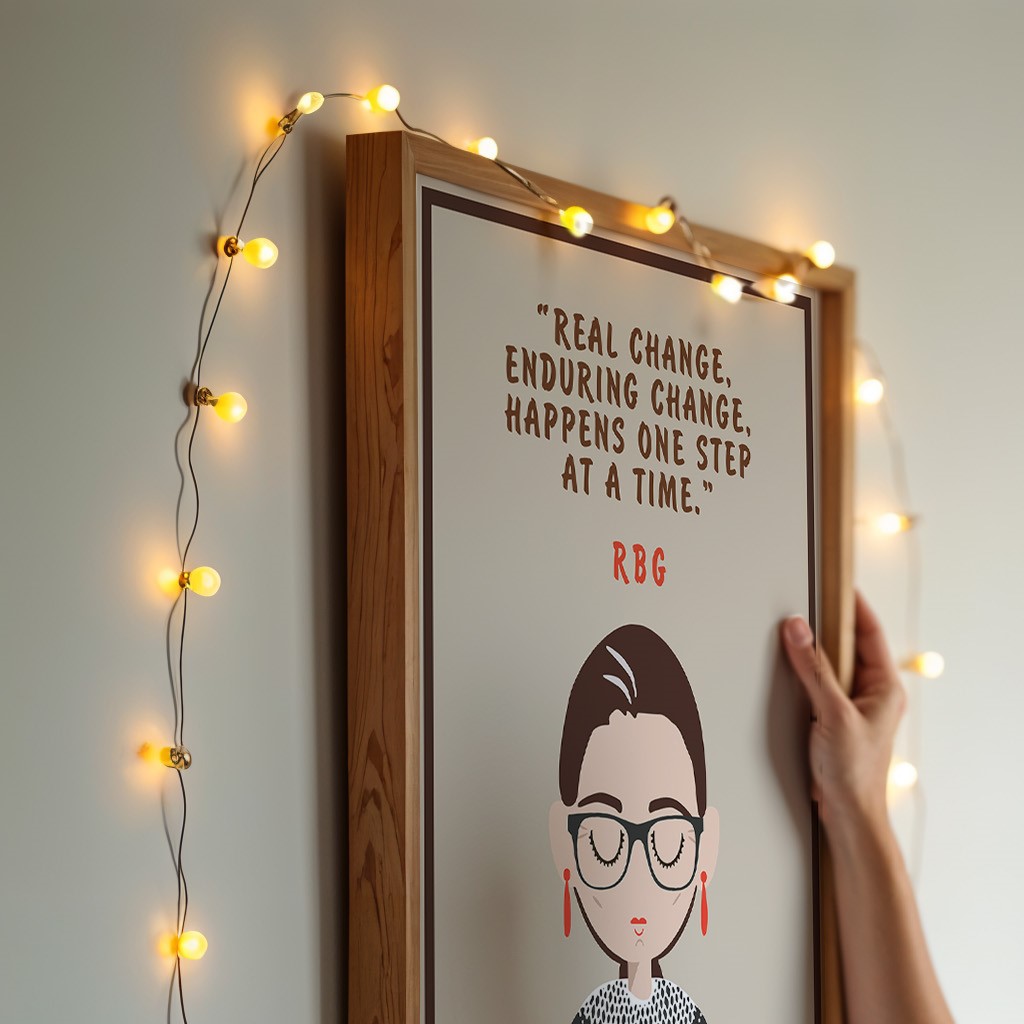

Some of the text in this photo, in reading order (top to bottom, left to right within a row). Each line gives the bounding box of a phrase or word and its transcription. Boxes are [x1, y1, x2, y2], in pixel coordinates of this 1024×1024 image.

[629, 326, 732, 389] CHANGE,
[505, 344, 752, 438] ENDURING CHANGE,
[504, 392, 752, 479] HAPPENS ONE STEP
[561, 453, 594, 496] AT
[604, 461, 622, 502] A
[612, 540, 667, 587] RBG
